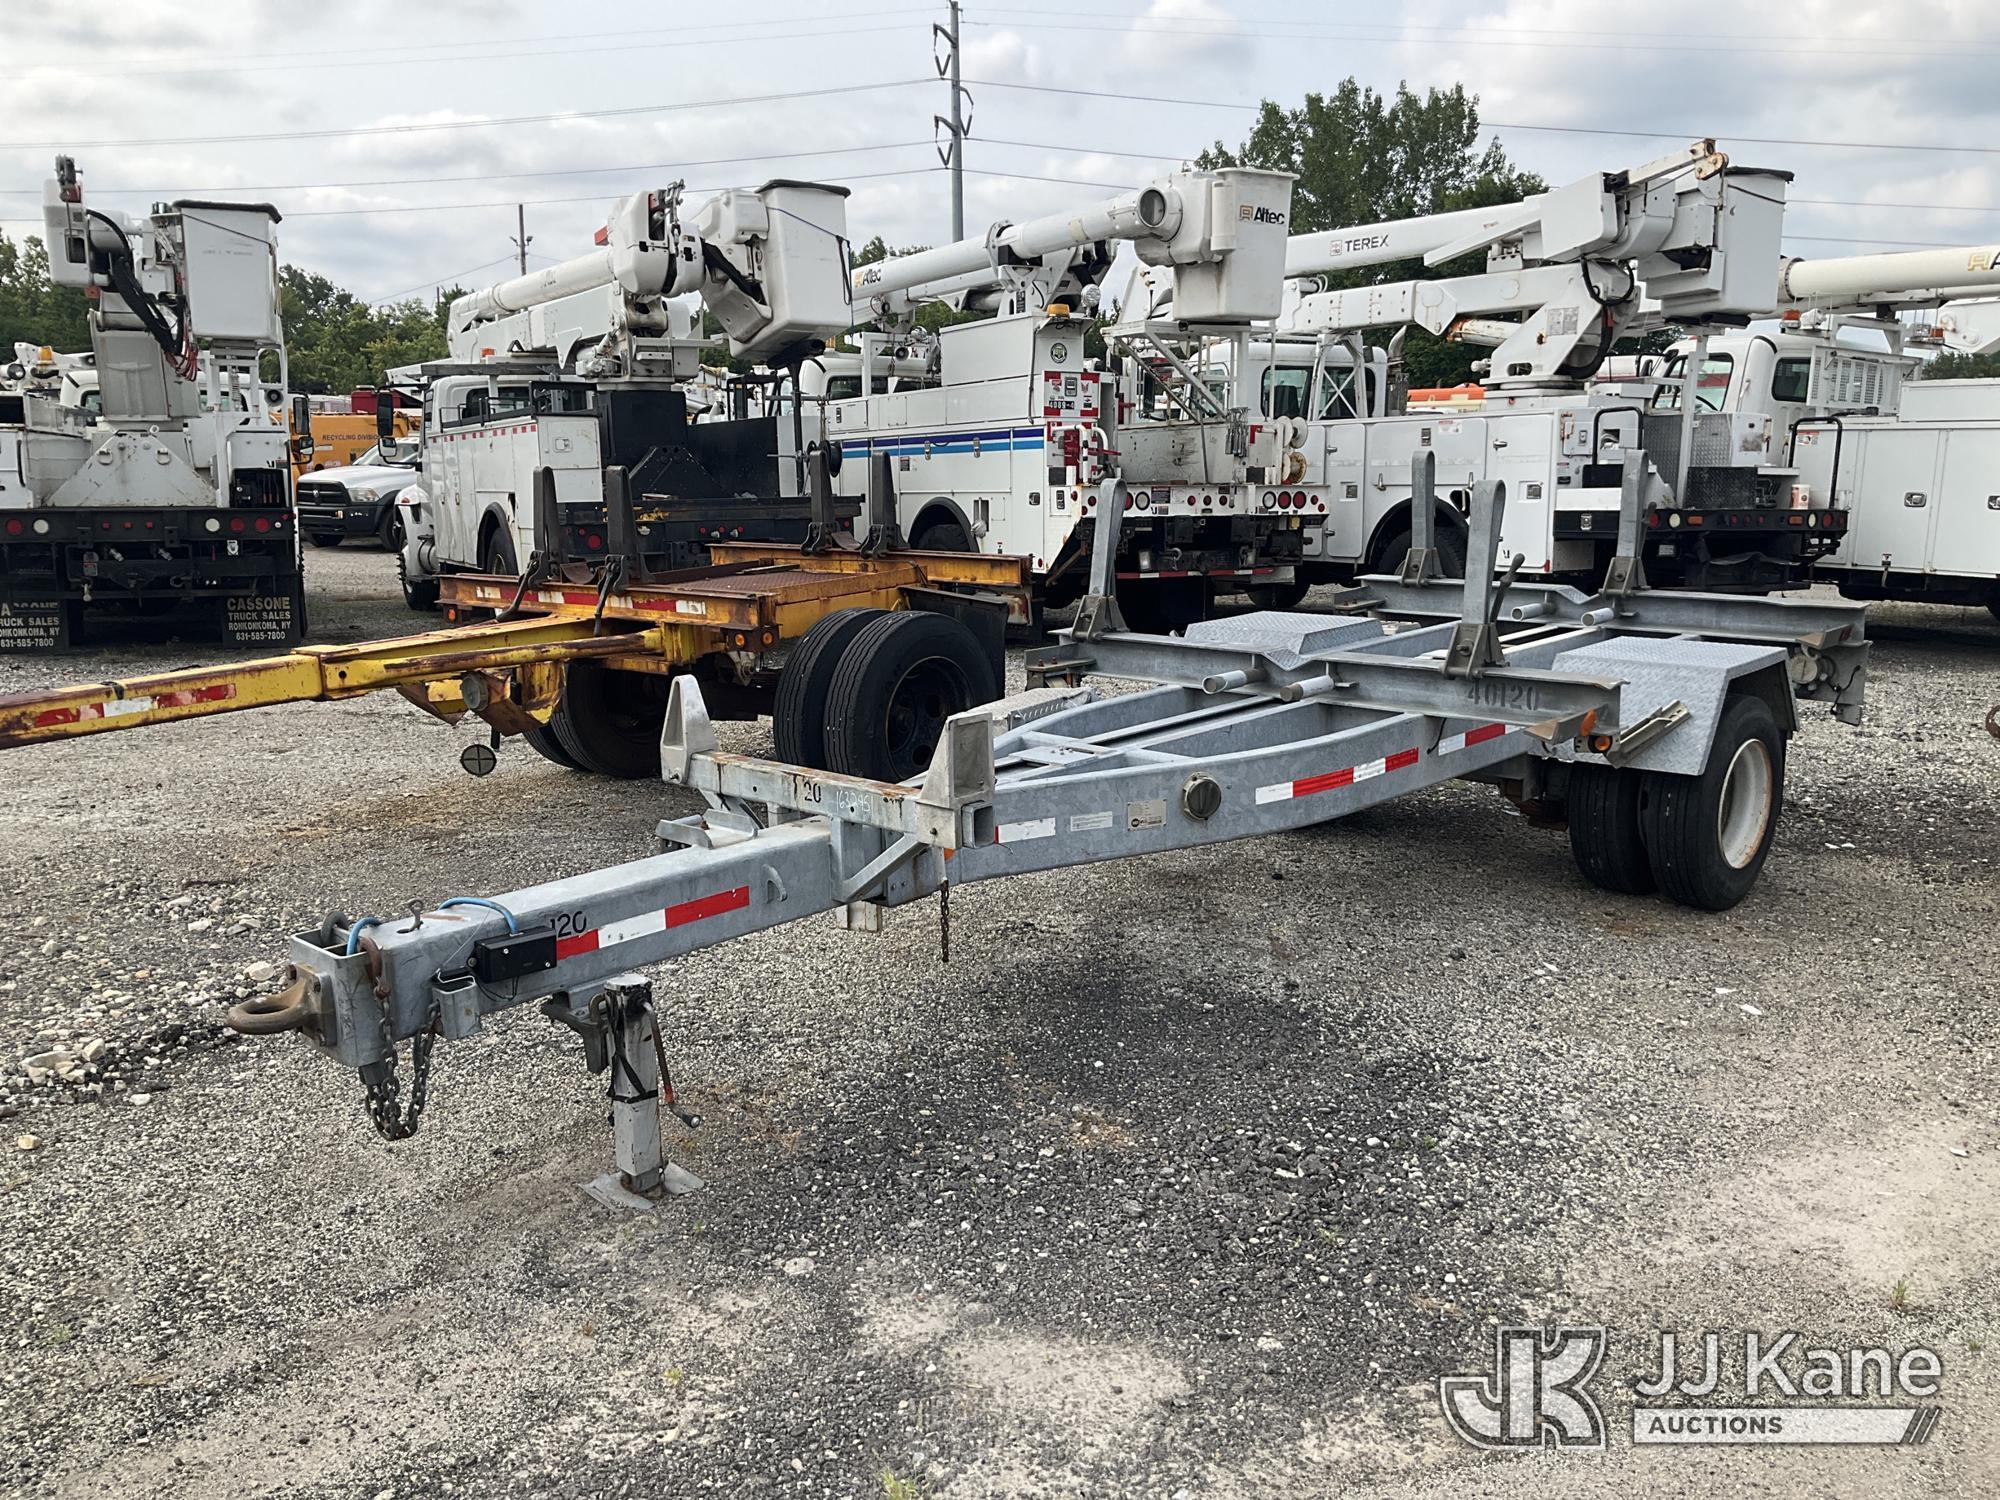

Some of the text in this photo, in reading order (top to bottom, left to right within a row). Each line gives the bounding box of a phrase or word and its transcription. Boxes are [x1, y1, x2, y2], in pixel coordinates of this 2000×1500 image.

[1253, 206, 1285, 225] Altec
[1344, 233, 1389, 252] TEREX
[227, 596, 291, 611] CASSONE
[28, 616, 60, 626] SALES
[228, 611, 291, 621] TRUCK SALES
[228, 620, 292, 631] RONKONKOMA, NY
[49, 627, 60, 636] NY
[235, 631, 286, 641] 631-585-7800
[0, 637, 54, 648] 631-585-7800
[1467, 679, 1539, 711] 40120
